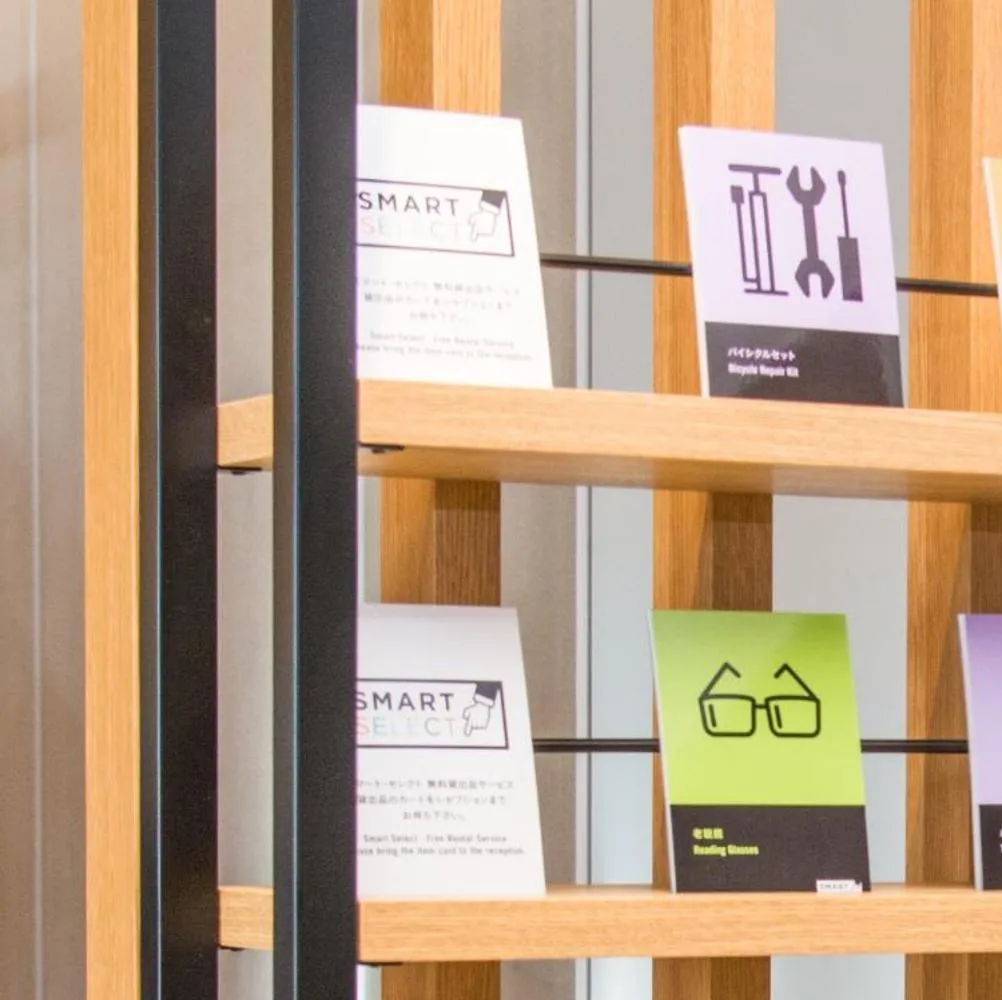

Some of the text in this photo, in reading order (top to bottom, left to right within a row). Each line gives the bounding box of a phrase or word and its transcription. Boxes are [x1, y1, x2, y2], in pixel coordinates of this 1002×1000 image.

[358, 191, 459, 216] SMART
[360, 216, 465, 240] SECT
[356, 692, 454, 711] SMART
[357, 717, 457, 737] SELECT
